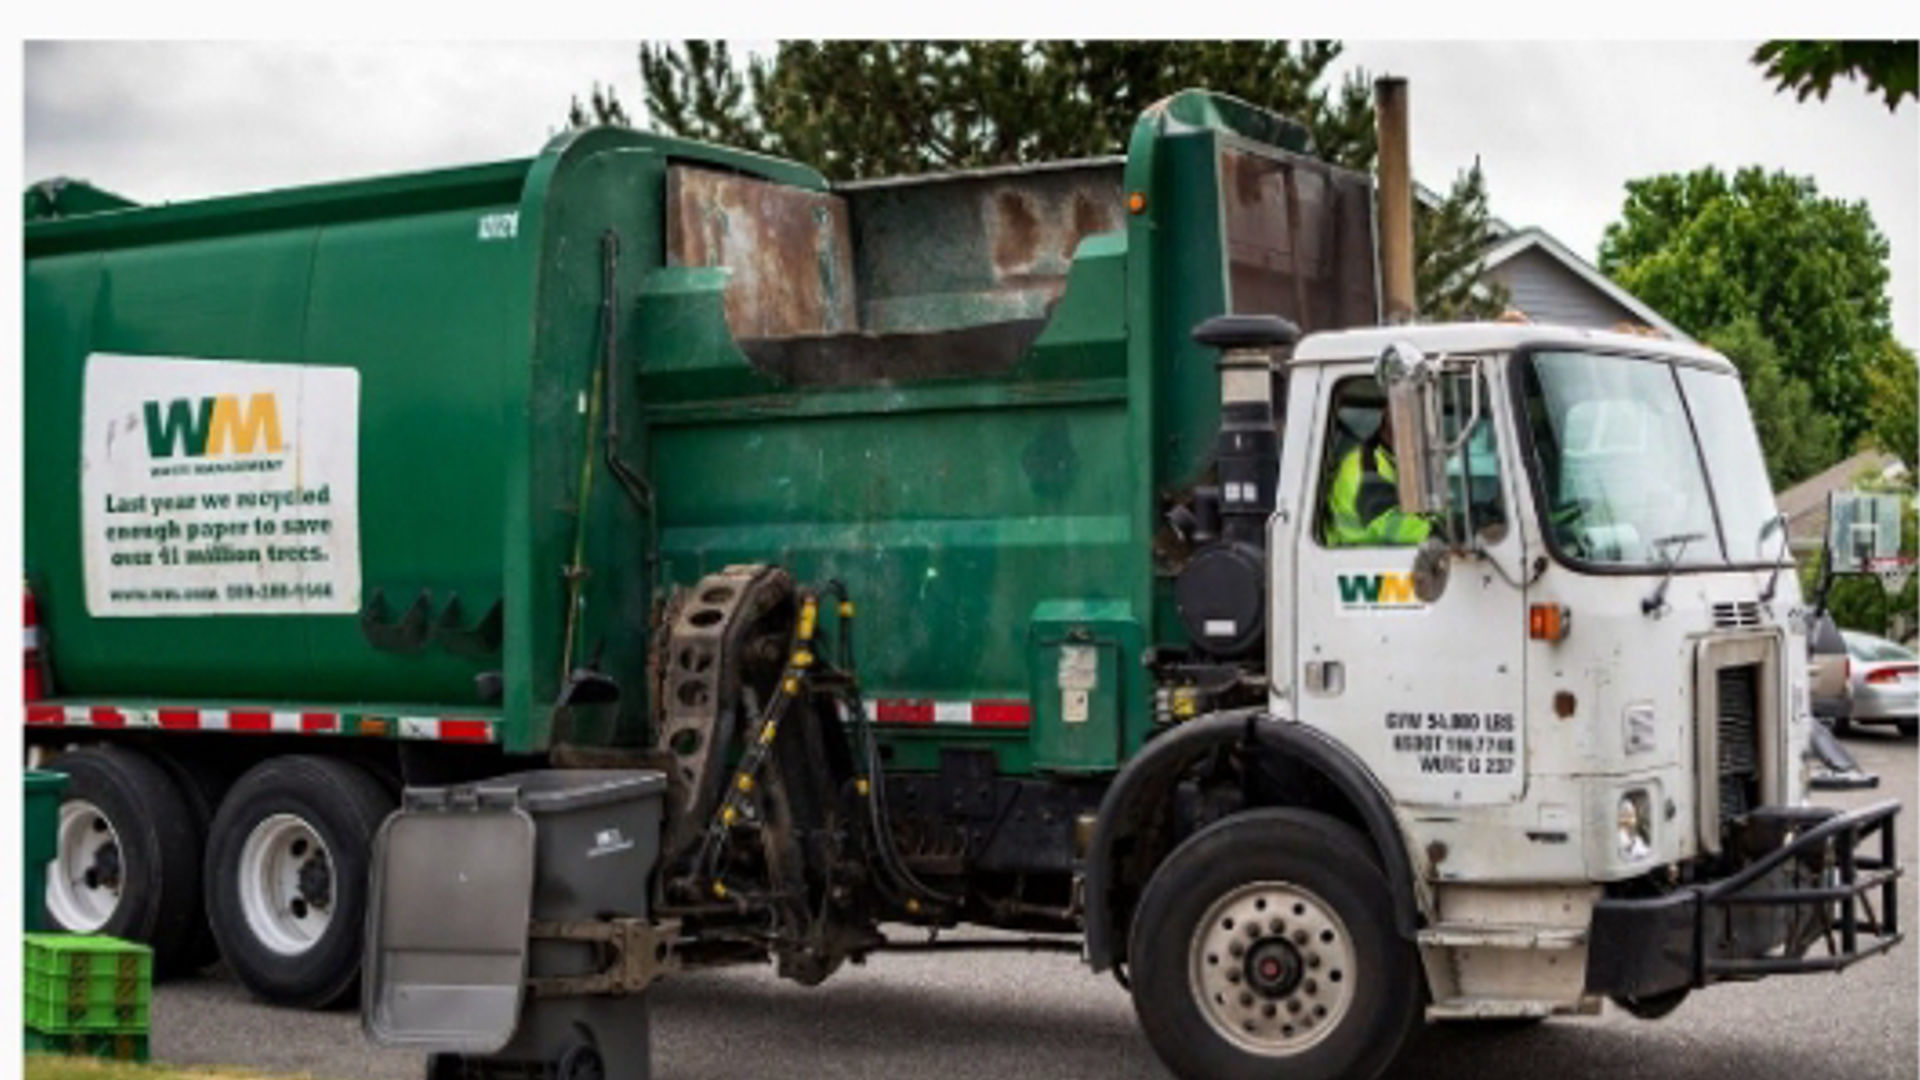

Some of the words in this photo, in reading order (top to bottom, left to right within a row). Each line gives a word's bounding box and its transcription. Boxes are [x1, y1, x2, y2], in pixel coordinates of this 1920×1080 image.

[143, 392, 282, 457] WM
[106, 493, 147, 514] Last
[151, 493, 197, 516] year
[202, 493, 231, 509] we
[236, 485, 331, 512] recycled
[106, 519, 181, 542] enough
[186, 521, 249, 542] paper
[253, 516, 277, 536] to
[281, 518, 332, 535] save
[110, 550, 152, 566] over
[185, 544, 261, 565] million
[266, 546, 329, 563] trees.
[1485, 712, 1515, 732] LBS
[1393, 735, 1442, 752] USDOT
